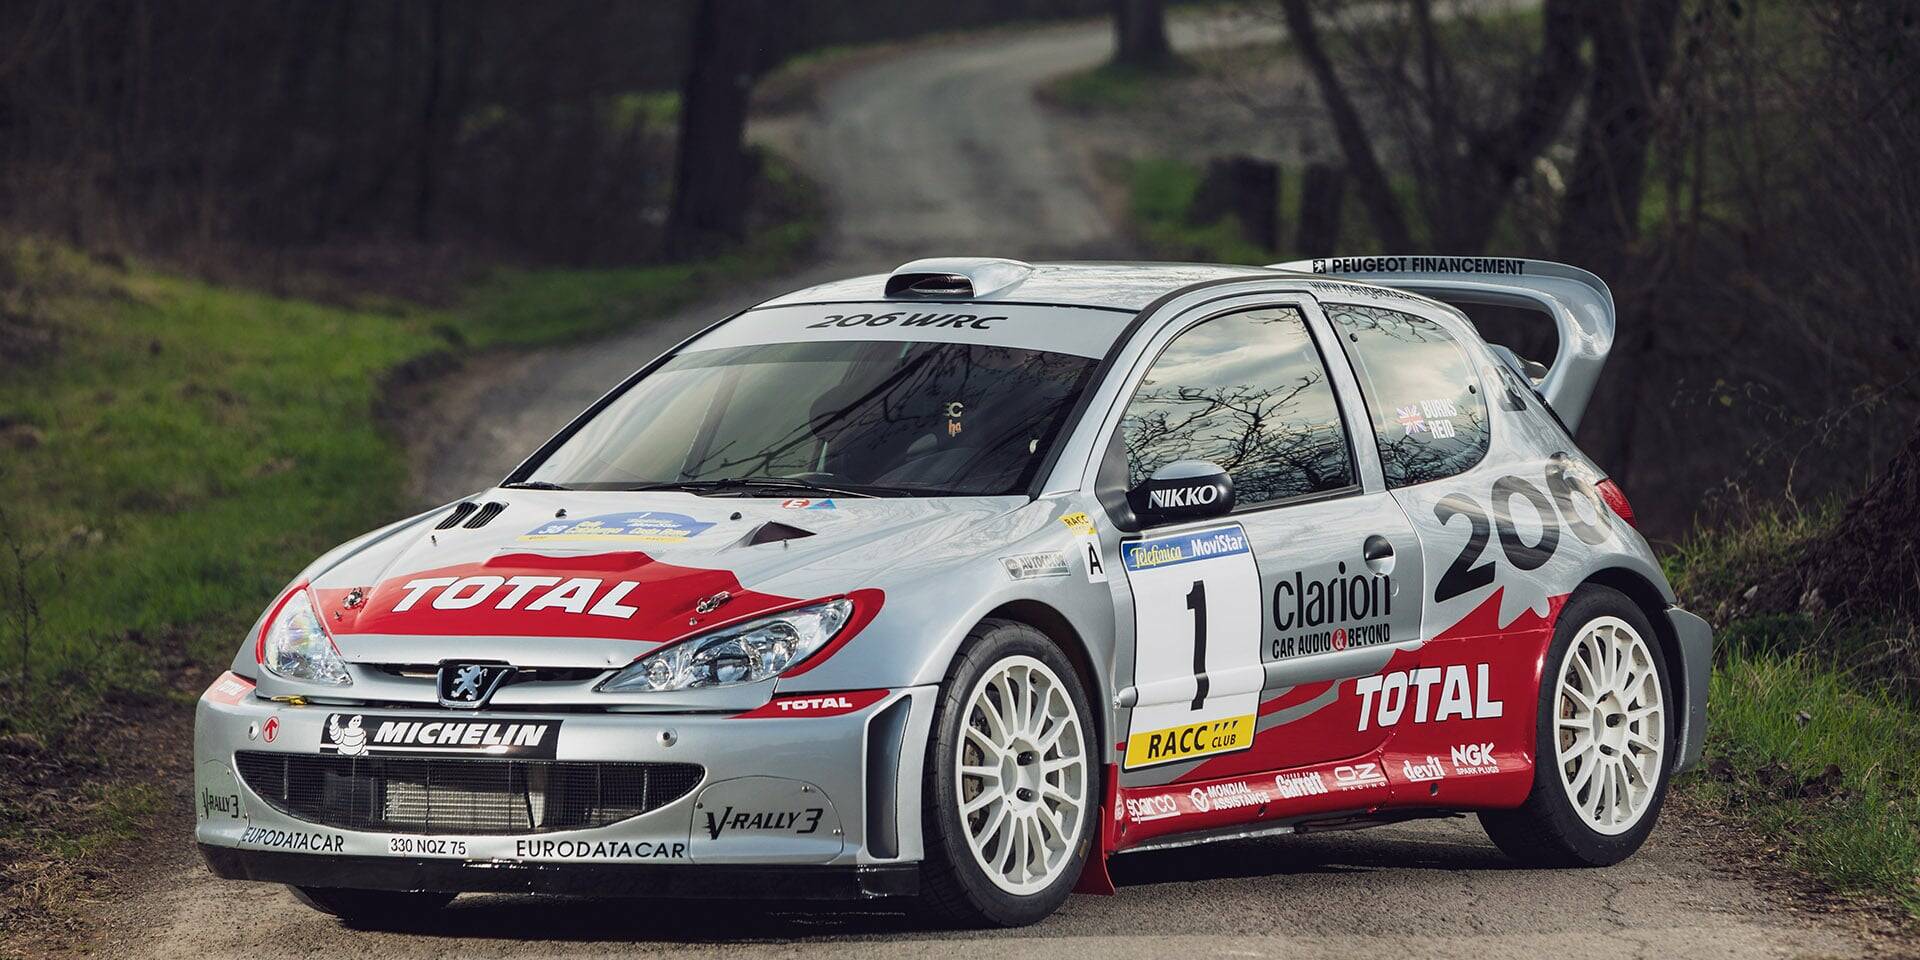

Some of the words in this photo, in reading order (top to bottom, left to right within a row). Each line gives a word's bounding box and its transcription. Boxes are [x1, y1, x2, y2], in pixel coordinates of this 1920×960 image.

[1332, 257, 1407, 273] PEUGEOT
[1412, 258, 1526, 275] FINANCEMENT
[806, 312, 907, 329] 206
[900, 312, 1009, 330] WRC
[1420, 399, 1458, 418] BURNS
[1428, 419, 1456, 439] REID
[1148, 485, 1218, 509] NIKKO
[1064, 515, 1089, 528] RACC
[1433, 451, 1613, 604] 206
[1190, 534, 1244, 557] MoviStar
[1087, 541, 1104, 575] A
[391, 576, 641, 619] TOTAL
[1273, 561, 1392, 631] clarion
[1186, 580, 1210, 711] 1
[1272, 637, 1295, 659] CAR
[1298, 631, 1332, 655] AUDIO
[1348, 623, 1391, 648] BEYOND
[777, 697, 853, 711] TOTAL
[1355, 663, 1503, 732] TOTAL
[373, 721, 548, 746] MICHELIN
[1147, 725, 1208, 759] RACC
[1211, 733, 1237, 748] CLUB
[1451, 742, 1497, 767] NGK
[1403, 756, 1446, 780] devil
[1455, 766, 1478, 775] SPARK
[1207, 781, 1251, 798] MONDIAL
[1275, 771, 1328, 798] Garrett
[1342, 782, 1386, 792] RACING
[1126, 794, 1177, 823] sparco
[1214, 791, 1272, 811] ASSISTANCE
[242, 826, 344, 853] EURODATACAR
[390, 838, 413, 853] 330
[417, 840, 447, 855] NQZ
[450, 842, 466, 855] 75
[516, 839, 686, 859] EURODATACAR
